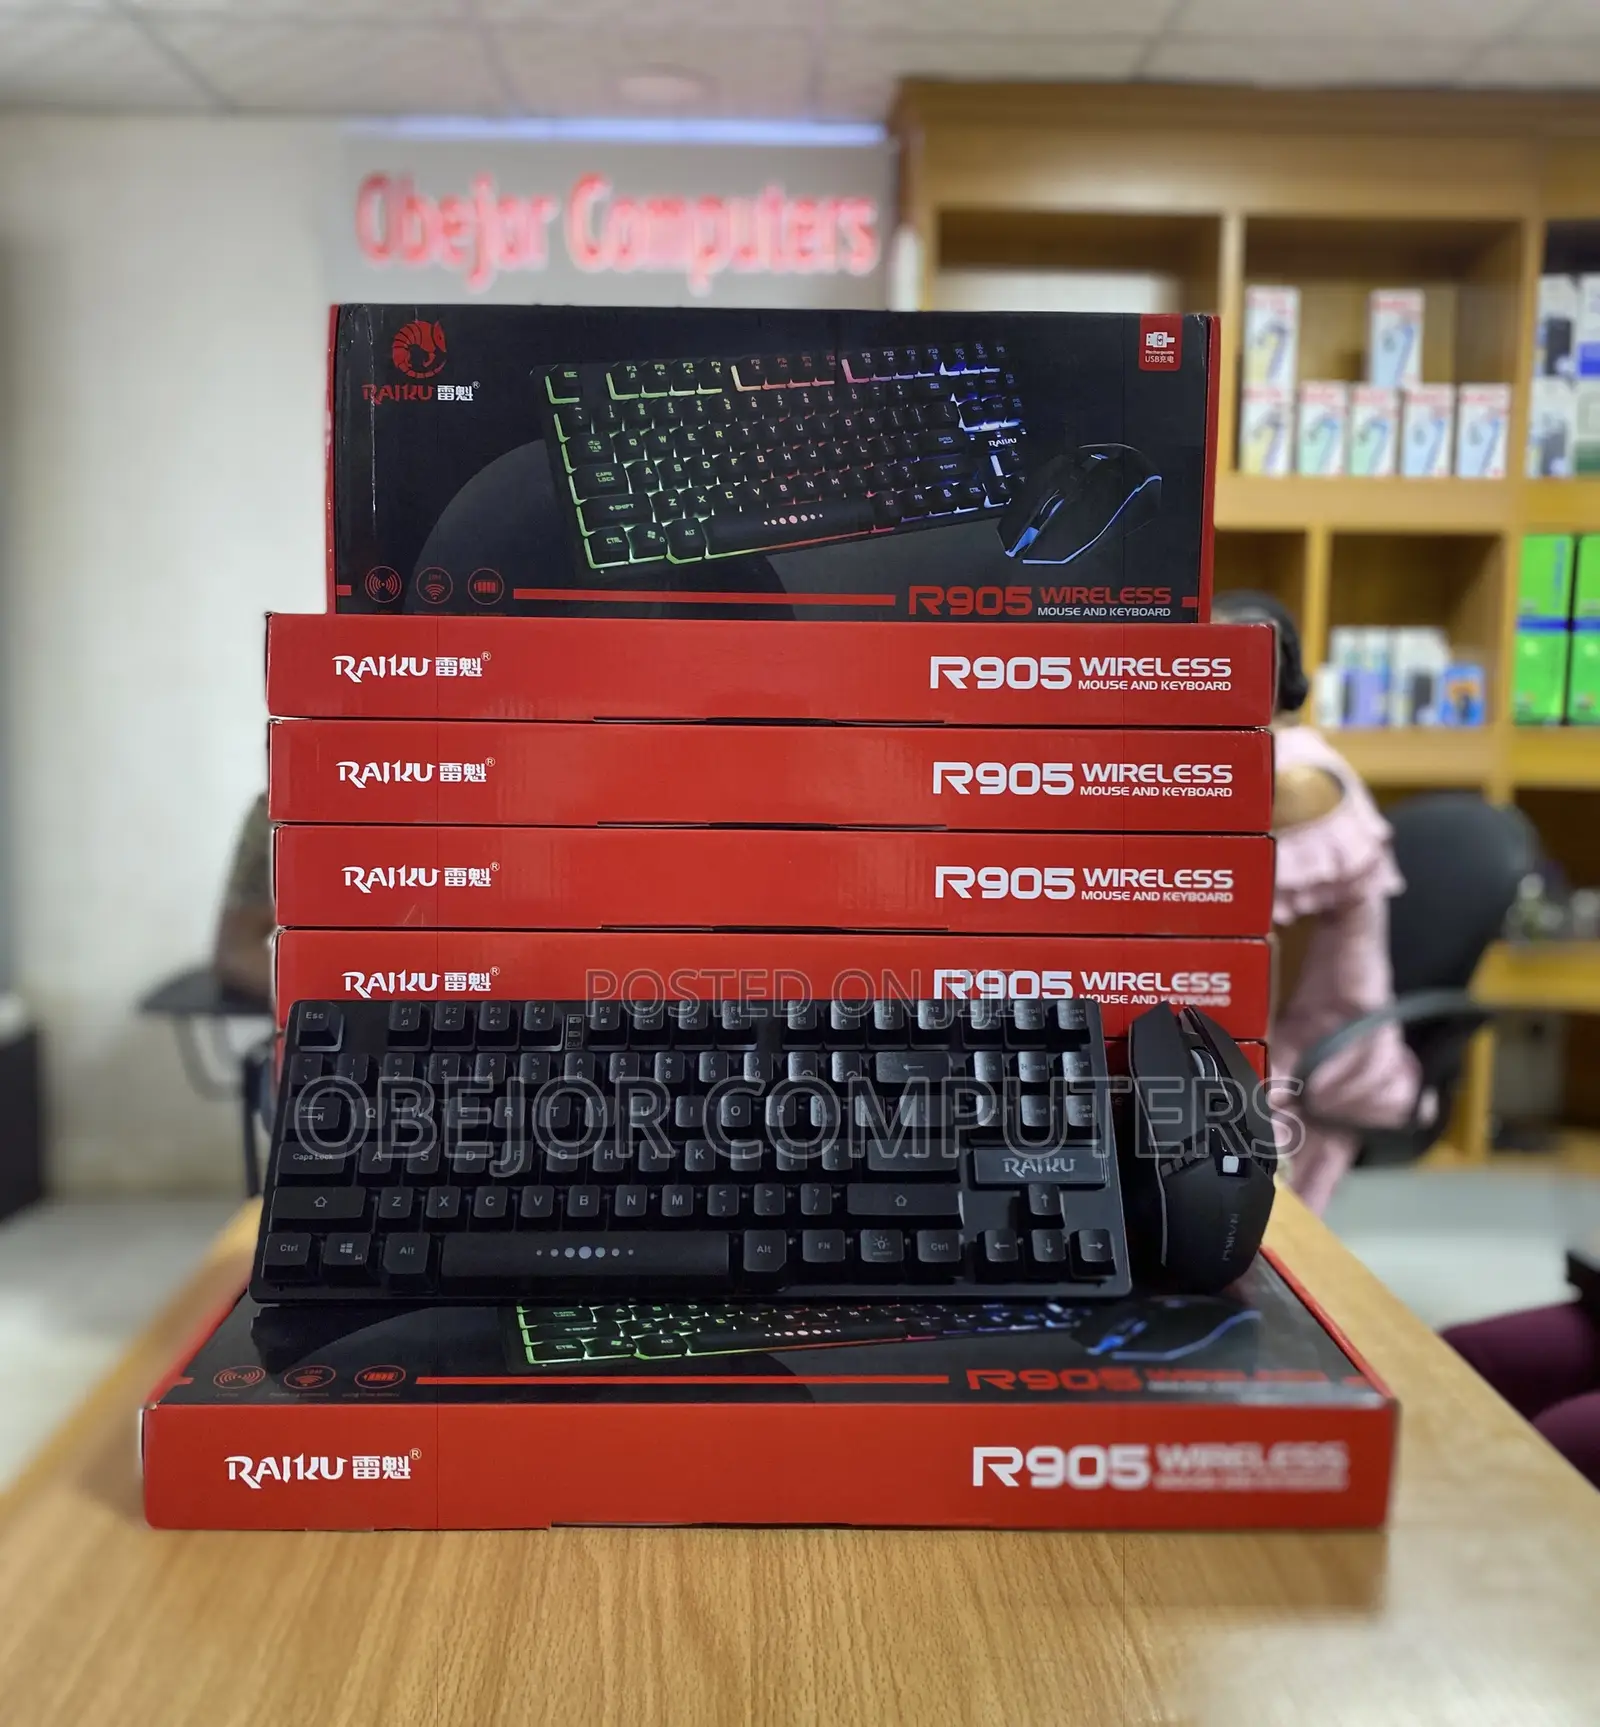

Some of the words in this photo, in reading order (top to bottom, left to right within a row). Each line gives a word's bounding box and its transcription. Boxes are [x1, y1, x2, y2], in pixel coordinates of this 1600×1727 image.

[357, 171, 555, 290] Obejor
[566, 171, 879, 295] Computers
[361, 383, 434, 405] RAIKU
[909, 586, 1033, 615] R905
[1040, 586, 1172, 605] WIRELESS
[1037, 607, 1081, 616] MOUSE
[1083, 607, 1107, 616] AND
[1109, 607, 1171, 617] KEYBOARD
[332, 654, 432, 683] RAIKU
[930, 656, 1072, 690] R905
[1079, 657, 1232, 678] WIRELESS
[1078, 680, 1128, 690] MOUSE
[1130, 680, 1158, 690] AND
[1161, 680, 1232, 691] KEYBOARD
[336, 760, 436, 789] RAIKU
[933, 762, 1075, 796] R905
[1081, 763, 1233, 784] WIRELESS
[1080, 786, 1129, 796] MOUSE
[1132, 786, 1160, 797] AND
[1162, 787, 1233, 797] KEYBOARD
[341, 864, 441, 893] RAIKU
[935, 866, 1076, 900] R905
[1082, 868, 1233, 889] WIRELESS
[1081, 890, 1131, 901] MOUSE
[1133, 891, 1161, 901] AND
[1163, 891, 1233, 902] KEYBOARD
[341, 969, 441, 999] RAIKU
[933, 969, 1074, 999] R905
[1080, 971, 1231, 992] WIRELESS
[1131, 994, 1158, 1004] AND
[1002, 1157, 1076, 1178] RAIKU
[392, 1197, 402, 1207] Z
[438, 1196, 449, 1207] X
[485, 1196, 496, 1207] C
[533, 1195, 543, 1206] V
[579, 1195, 589, 1206] B
[626, 1195, 637, 1206] N
[671, 1194, 683, 1206] M
[280, 1243, 299, 1252] Ctrl
[400, 1246, 416, 1255] Alt
[756, 1245, 772, 1254] Alt
[930, 1242, 949, 1251] Ctrl
[966, 1369, 1141, 1392] R905
[224, 1453, 348, 1489] RAIKU
[973, 1445, 1150, 1490] R905
